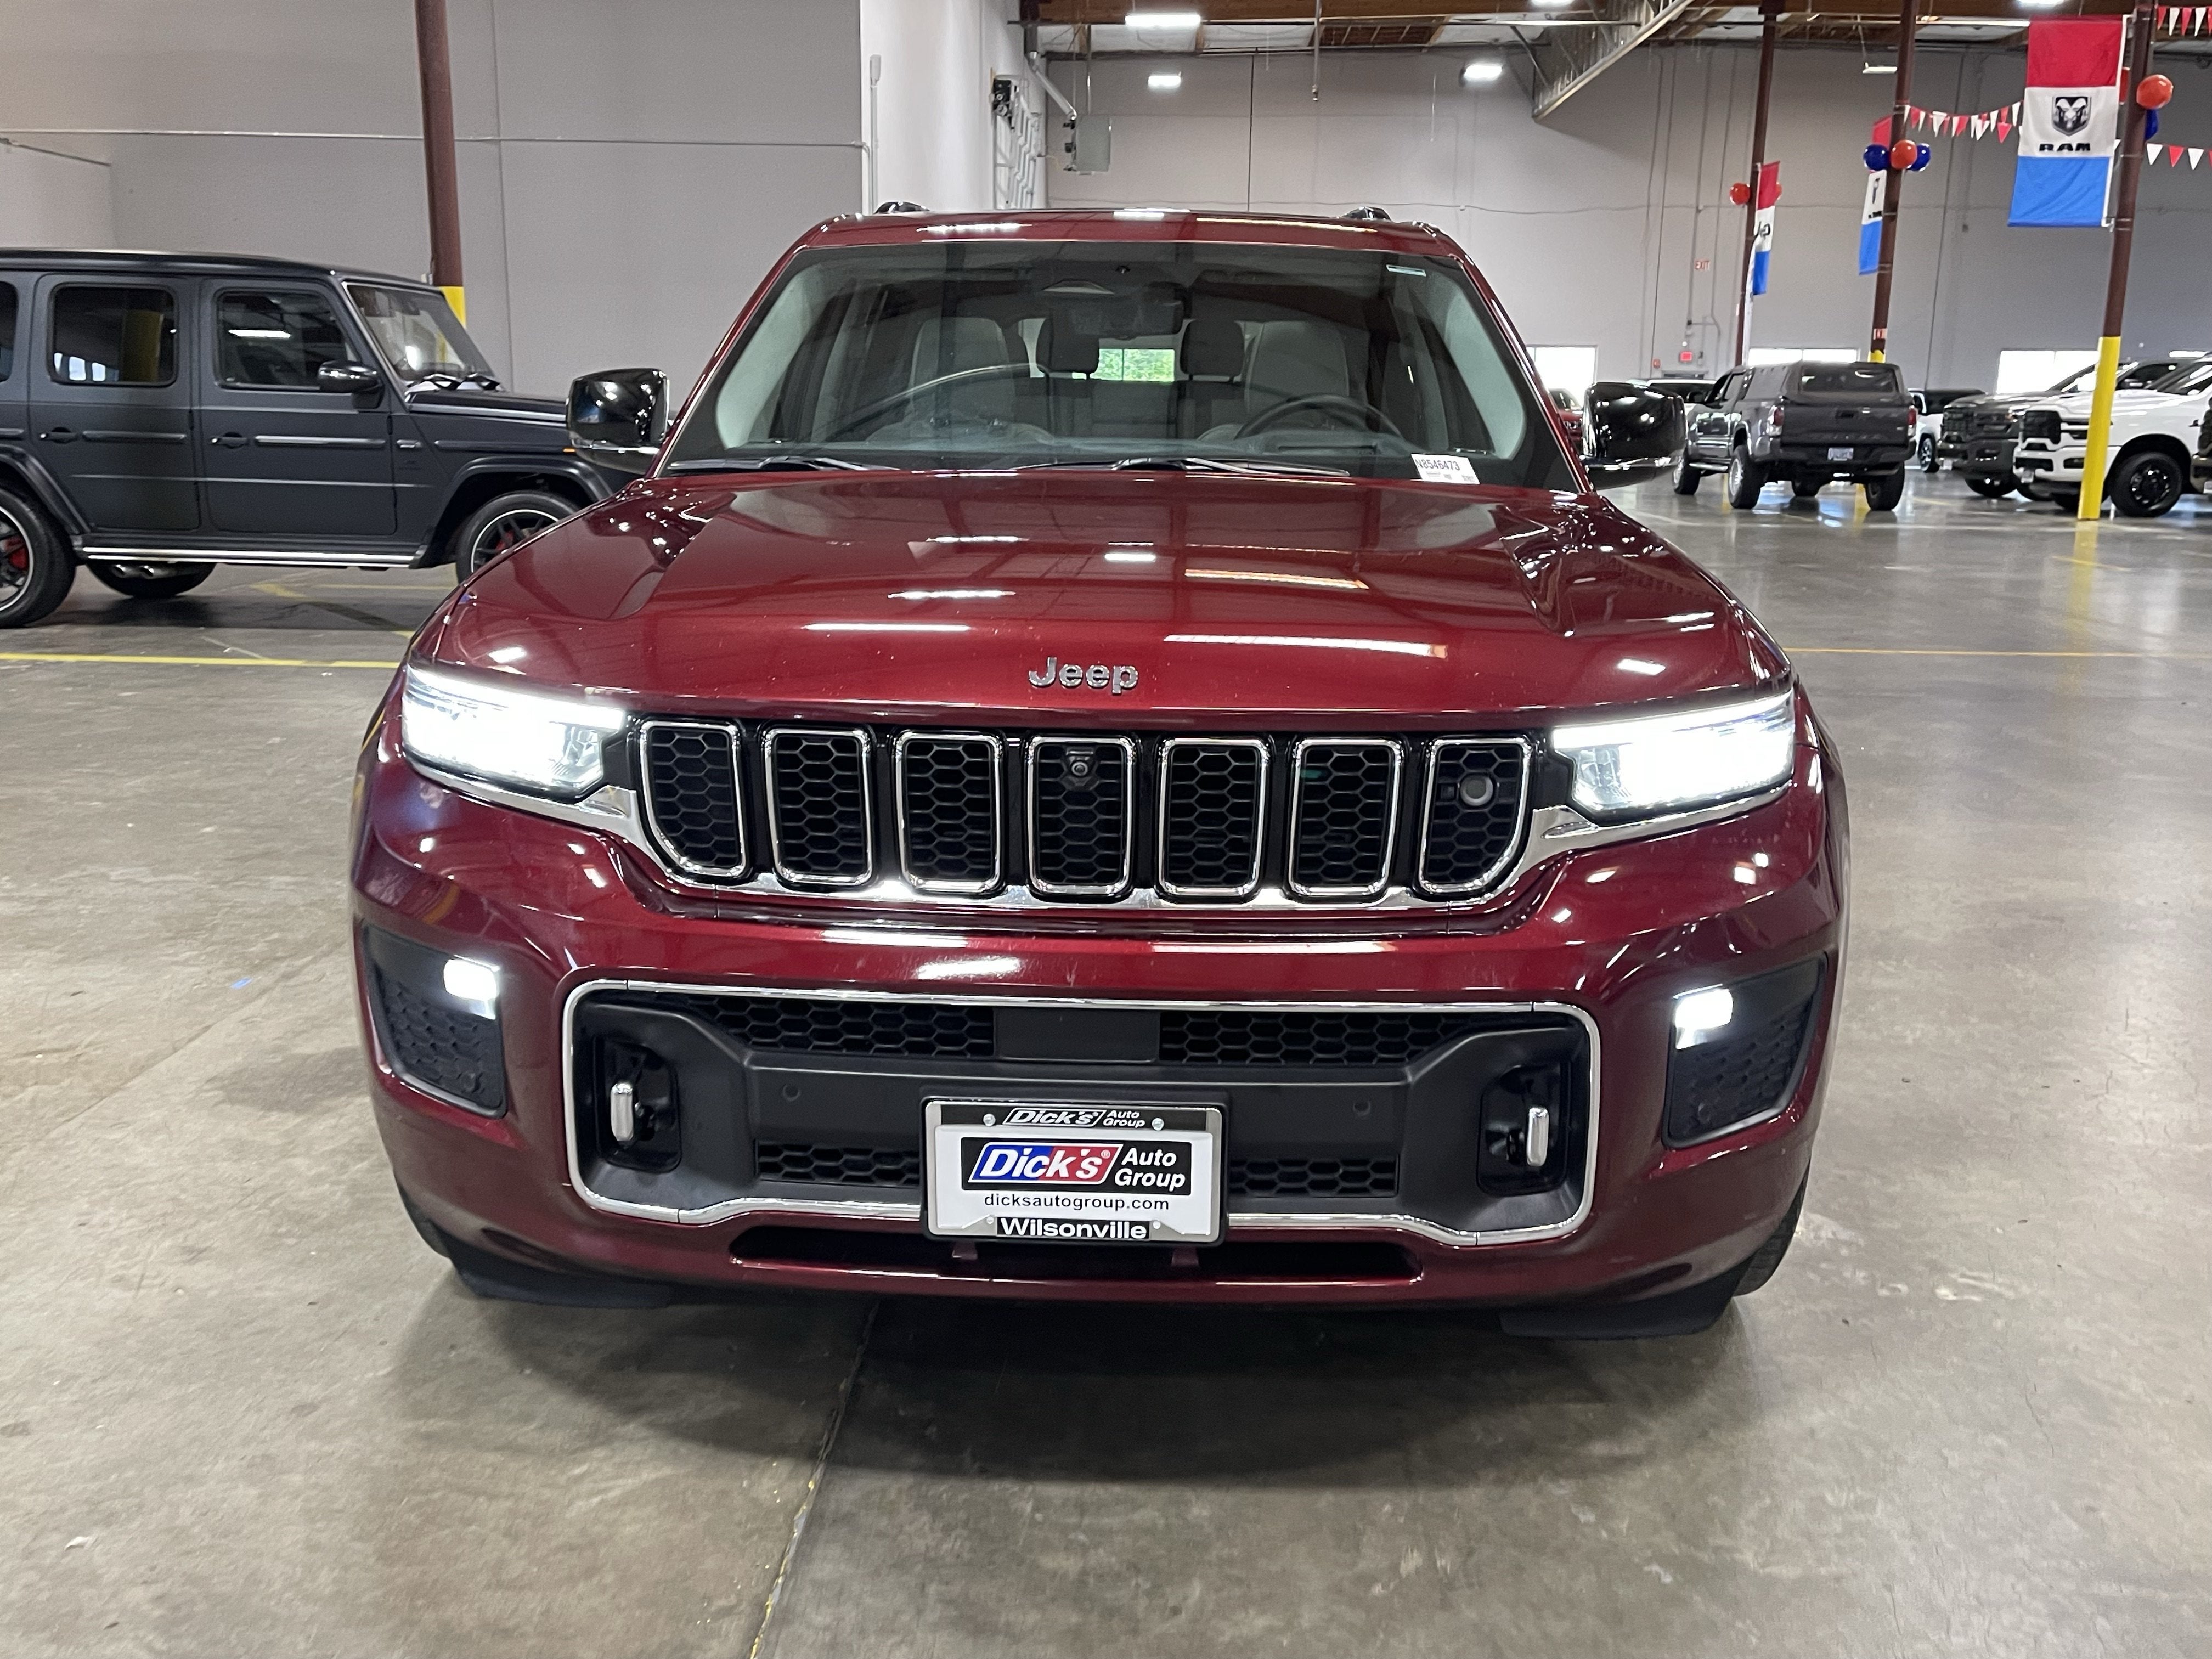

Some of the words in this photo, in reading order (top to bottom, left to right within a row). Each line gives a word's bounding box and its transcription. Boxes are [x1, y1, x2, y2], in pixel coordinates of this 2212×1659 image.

[2039, 143, 2091, 151] RAM
[1029, 657, 1138, 695] Jeep
[1103, 1118, 1146, 1128] Group
[1107, 1110, 1140, 1118] Auto
[1121, 1148, 1177, 1167] Auto
[1115, 1169, 1186, 1192] Group
[984, 1193, 1169, 1211] dicksautogroup.com
[1000, 1217, 1147, 1239] Wilsonville
